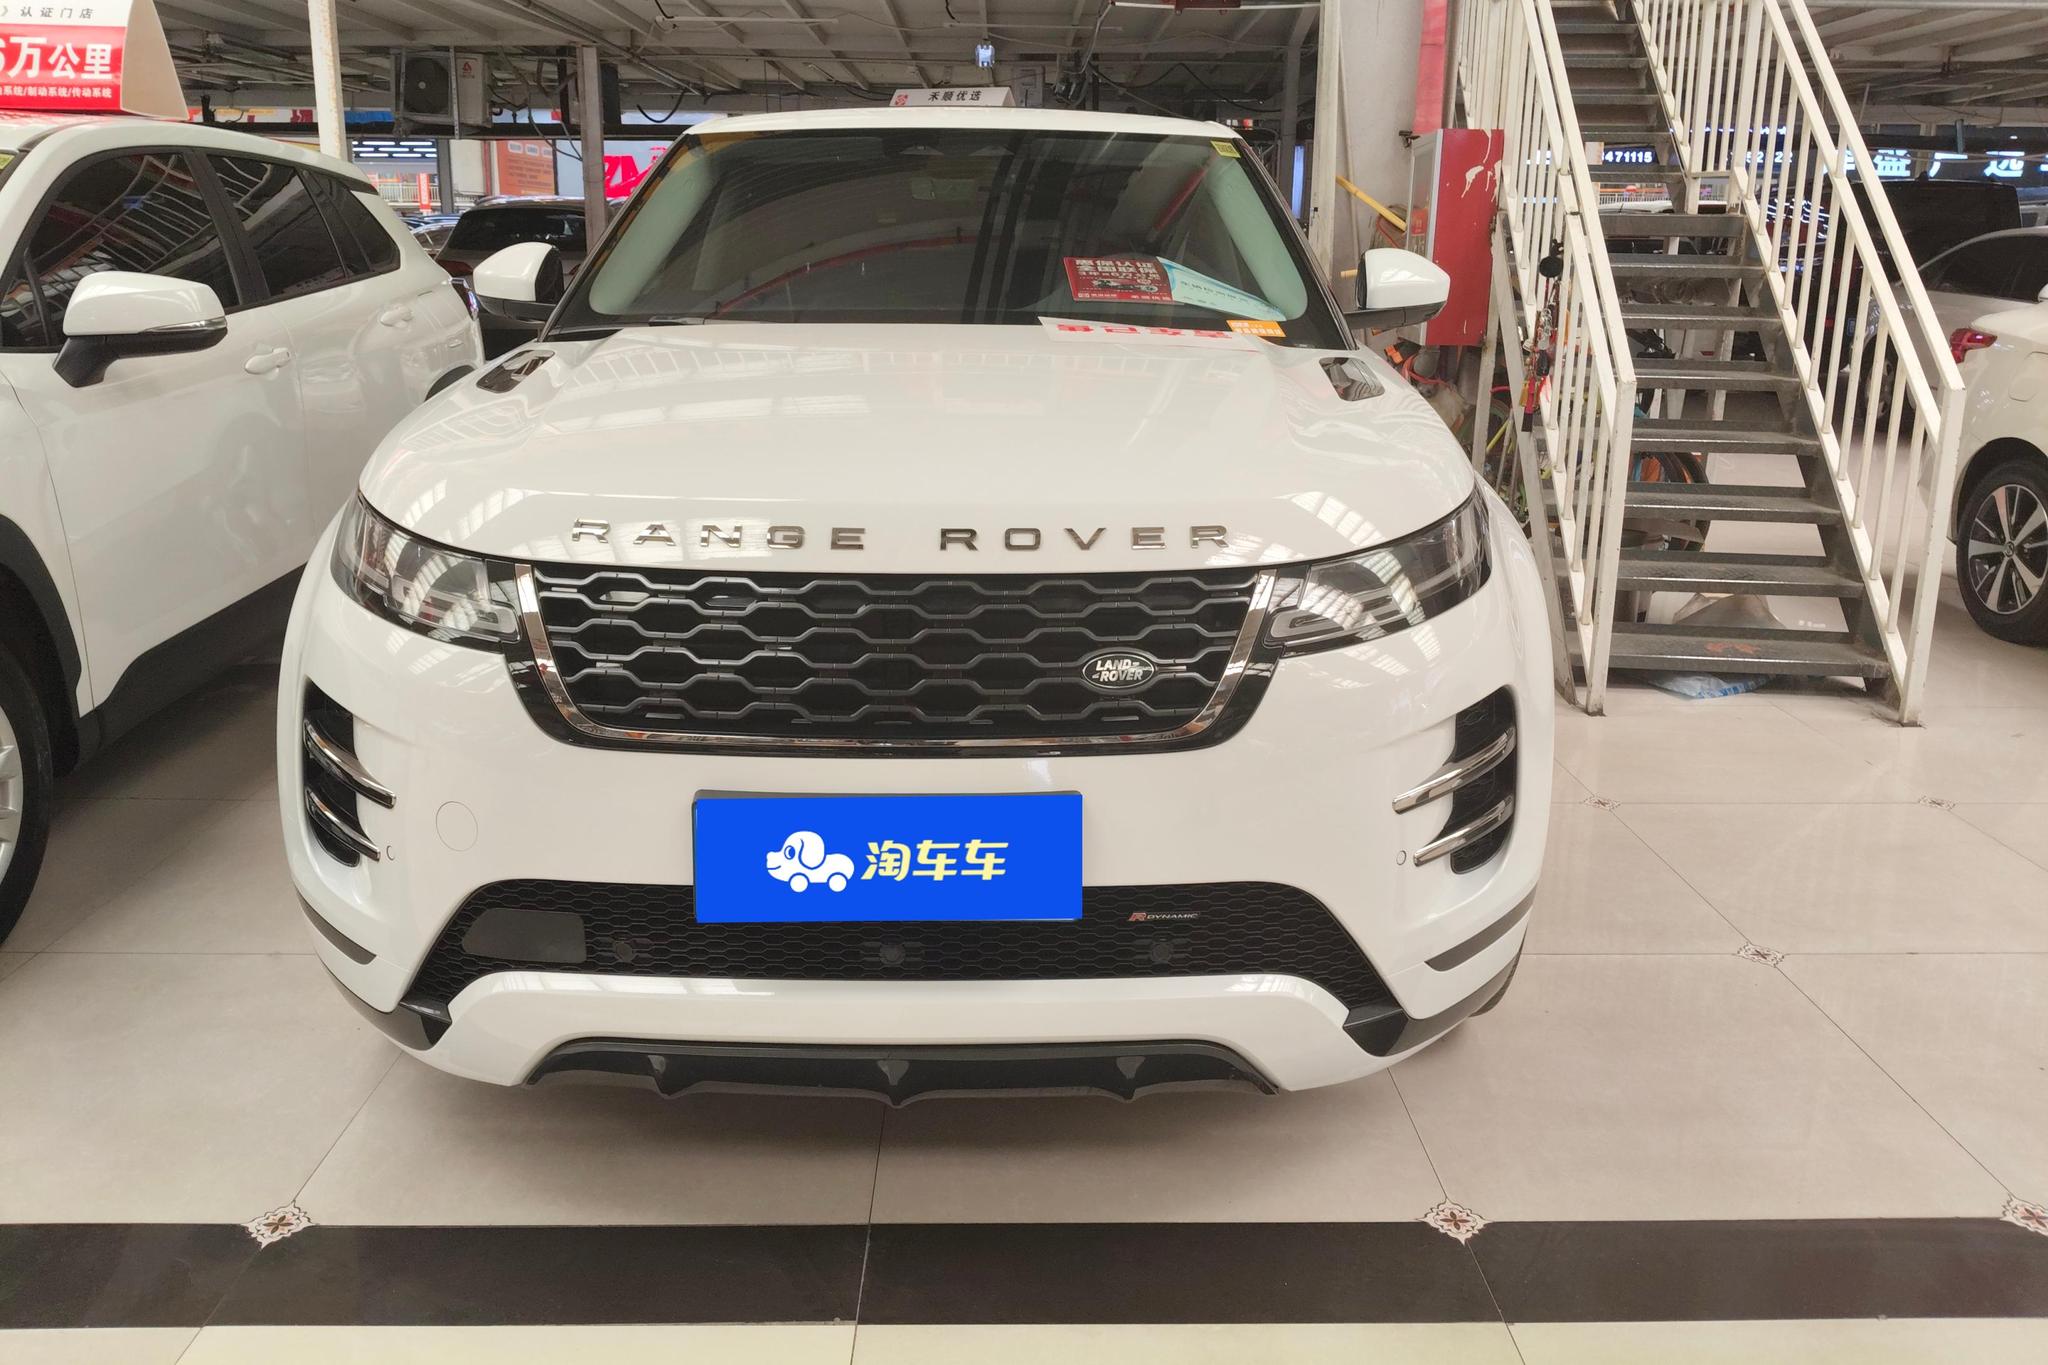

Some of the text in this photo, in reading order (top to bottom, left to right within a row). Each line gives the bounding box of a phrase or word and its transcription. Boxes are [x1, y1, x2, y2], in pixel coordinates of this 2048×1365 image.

[20, 6, 94, 19] 认证门店
[0, 85, 112, 98] 系统/制动系统/传动系统
[1602, 151, 1653, 163] 471115
[571, 517, 1231, 552] RANGE ROVER
[1095, 658, 1132, 671] LAND
[1099, 669, 1143, 682] ROVER
